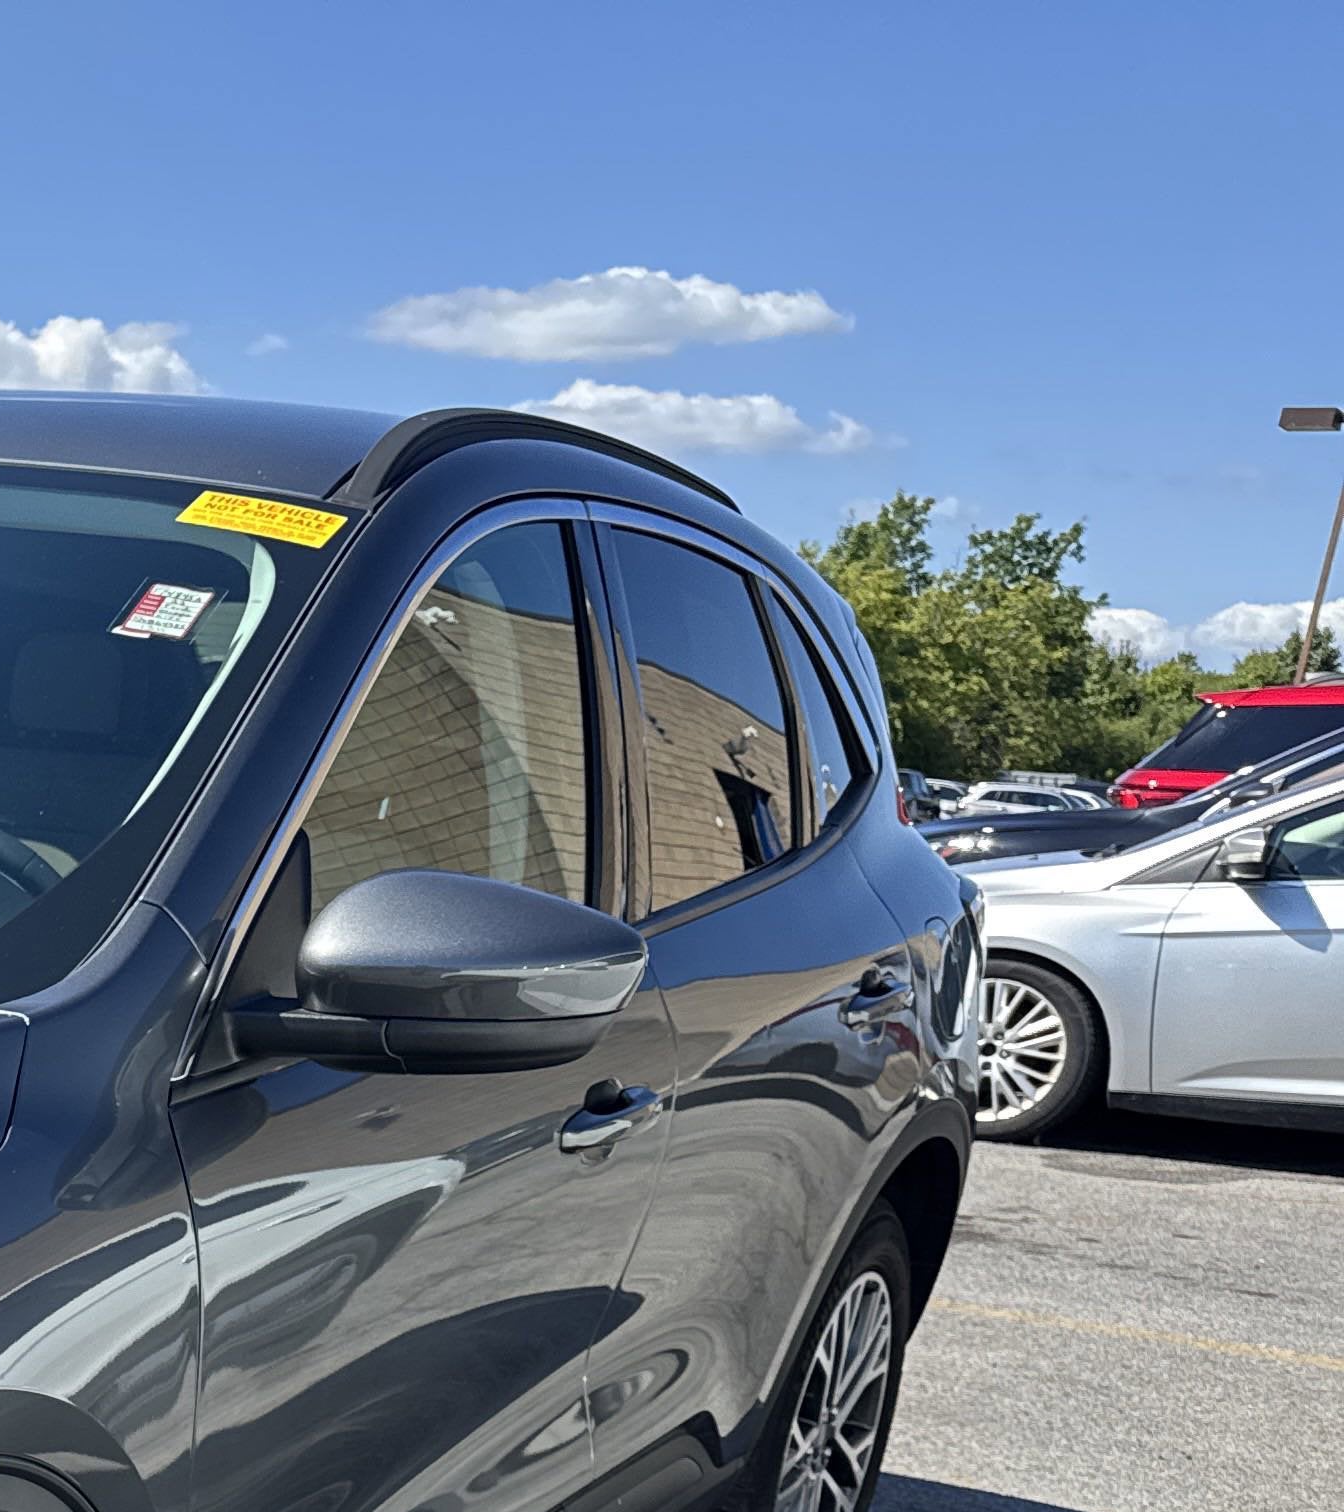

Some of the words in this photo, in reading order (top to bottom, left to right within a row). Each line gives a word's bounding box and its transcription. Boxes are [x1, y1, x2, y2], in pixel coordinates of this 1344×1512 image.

[203, 502, 237, 512] NOT
[242, 507, 280, 520] FOR
[283, 516, 329, 530] SALE
[207, 494, 250, 508] THIS
[256, 501, 340, 525] VEHICLE
